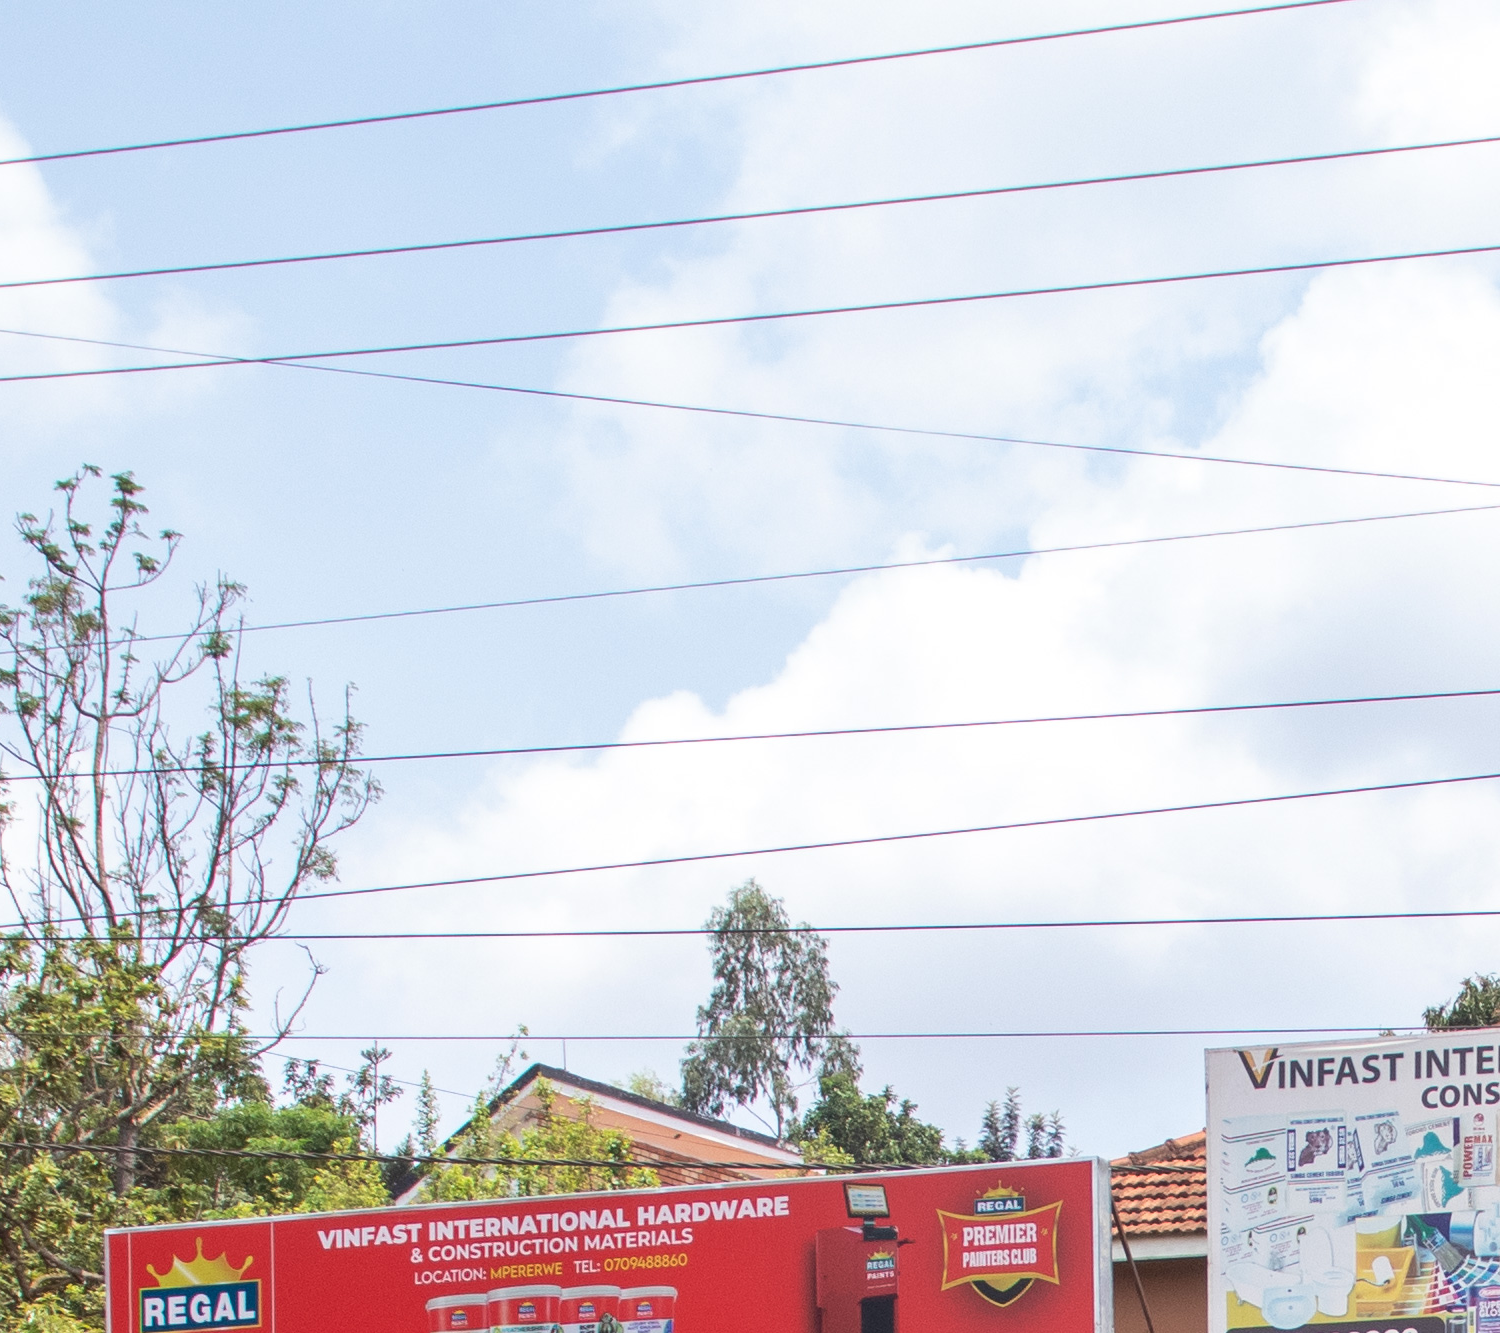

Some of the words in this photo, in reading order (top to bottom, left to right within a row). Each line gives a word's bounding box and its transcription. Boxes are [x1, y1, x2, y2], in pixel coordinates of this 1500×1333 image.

[1237, 1047, 1404, 1089] VINFAST
[1474, 1135, 1493, 1144] MAX
[1463, 1136, 1473, 1178] POWER
[977, 1201, 1022, 1213] REGAL
[318, 1223, 422, 1250] VINFAST
[429, 1208, 630, 1242] INTERNATIONAL
[637, 1196, 789, 1226] HARDWARE
[963, 1223, 1037, 1246] PREMIER
[410, 1248, 423, 1263] &
[428, 1236, 578, 1262] CONSTRUCTION
[584, 1228, 693, 1250] MATERIALS
[963, 1250, 1009, 1268] PAINTERS
[1011, 1248, 1037, 1265] CLUB
[414, 1267, 487, 1285] LOCATION:
[490, 1262, 563, 1280] MPERERWE
[574, 1260, 601, 1274] TEL:
[604, 1253, 688, 1272] 0709488860
[866, 1259, 894, 1270] REGAL
[866, 1270, 895, 1280] PAINTS
[144, 1290, 256, 1327] REGAL
